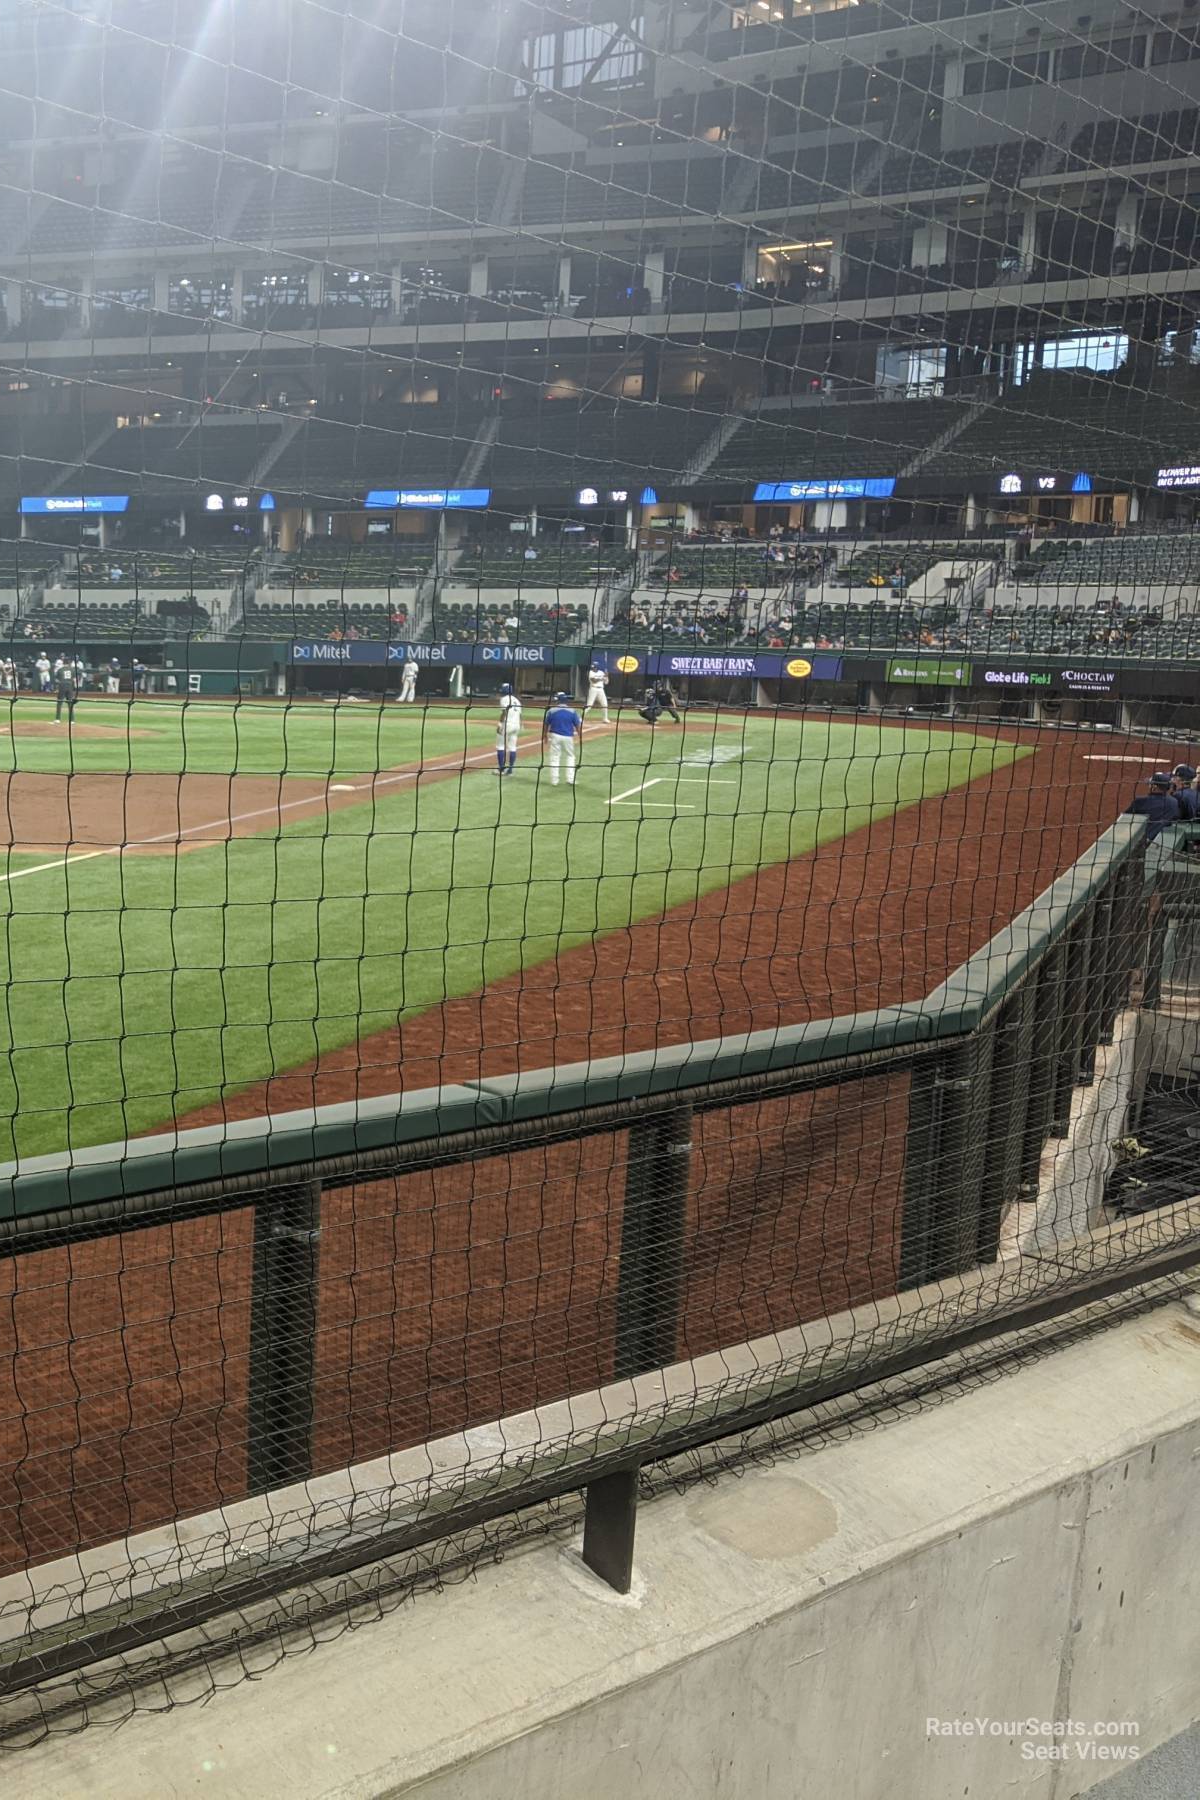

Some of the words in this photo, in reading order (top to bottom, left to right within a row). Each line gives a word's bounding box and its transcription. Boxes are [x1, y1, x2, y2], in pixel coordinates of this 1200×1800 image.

[1158, 468, 1189, 477] FLOWER
[1039, 478, 1056, 489] VS
[612, 491, 628, 501] VS
[234, 497, 248, 507] VS
[312, 645, 350, 660] Mitel
[407, 645, 446, 660] Mitel
[504, 647, 544, 662] Mitel
[672, 657, 702, 670] SWEET
[985, 671, 1011, 682] Globe
[1065, 670, 1115, 682] CHOCTAW
